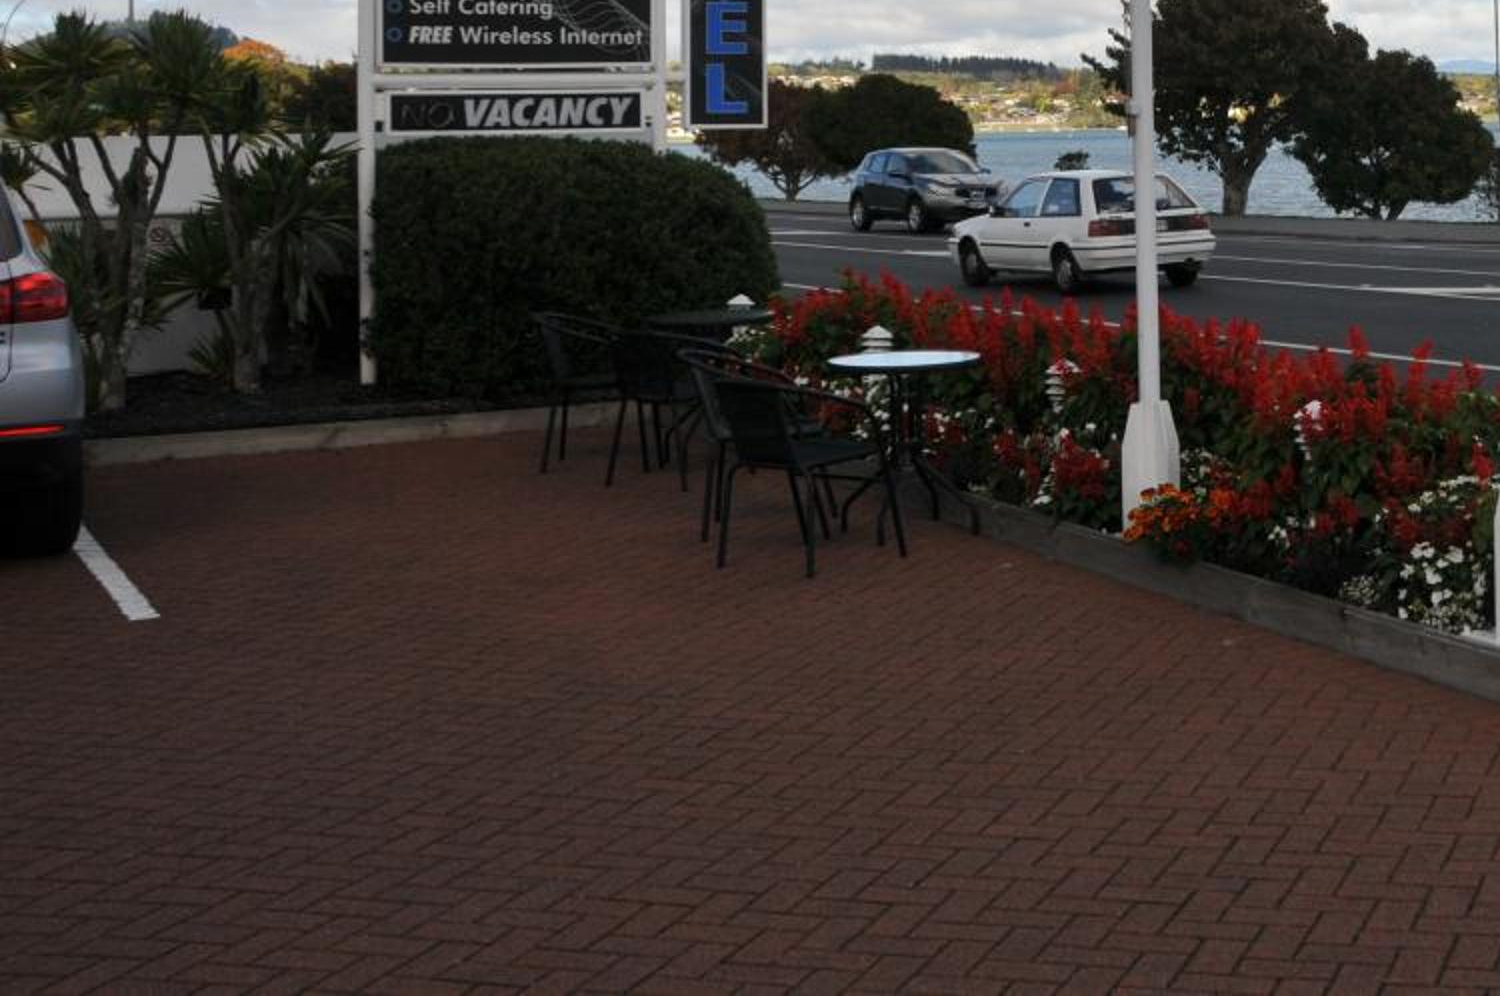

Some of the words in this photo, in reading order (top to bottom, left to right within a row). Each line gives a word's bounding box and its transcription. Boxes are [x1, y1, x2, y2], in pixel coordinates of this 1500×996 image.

[408, 26, 453, 44] FREE
[460, 26, 553, 44] Wireless
[560, 27, 642, 45] Internet
[401, 100, 453, 128] NO
[464, 97, 633, 127] VACANCY
